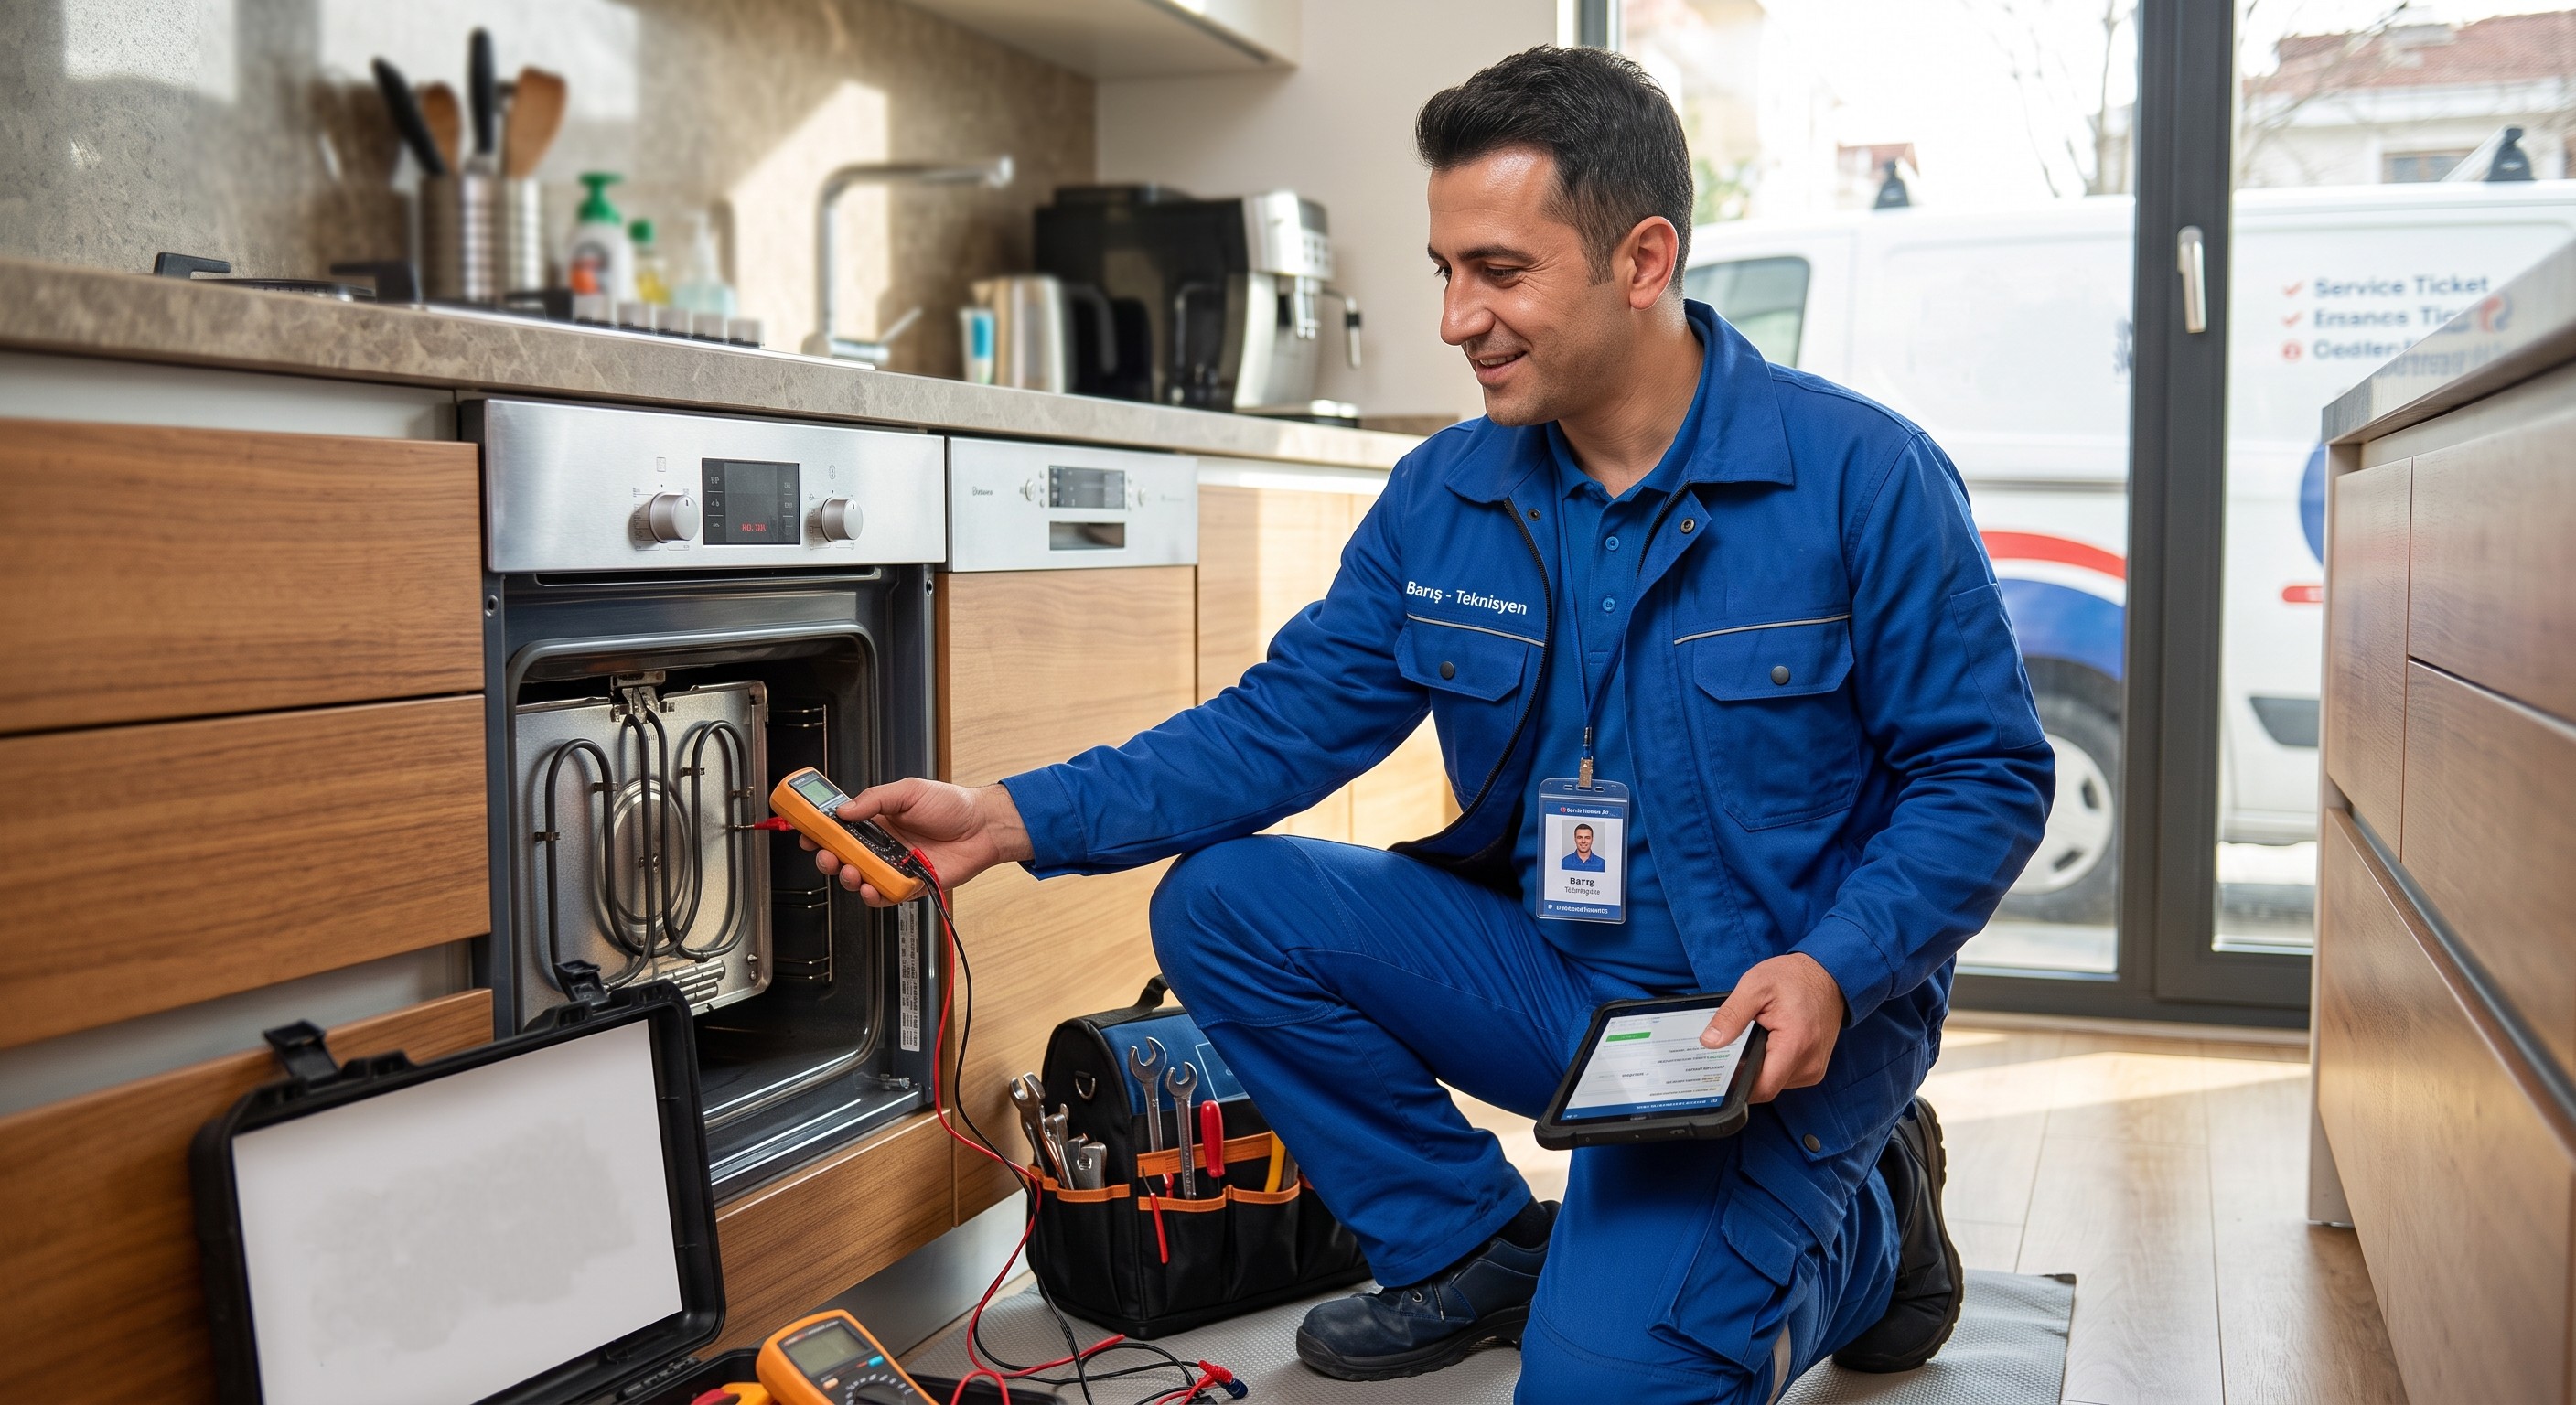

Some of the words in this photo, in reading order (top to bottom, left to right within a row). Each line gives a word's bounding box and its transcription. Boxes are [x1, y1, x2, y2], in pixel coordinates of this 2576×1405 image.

[2314, 277, 2406, 297] Service
[2414, 275, 2489, 296] Ticket
[1406, 581, 1443, 604] Barış
[1456, 590, 1528, 616] Teknisyen
